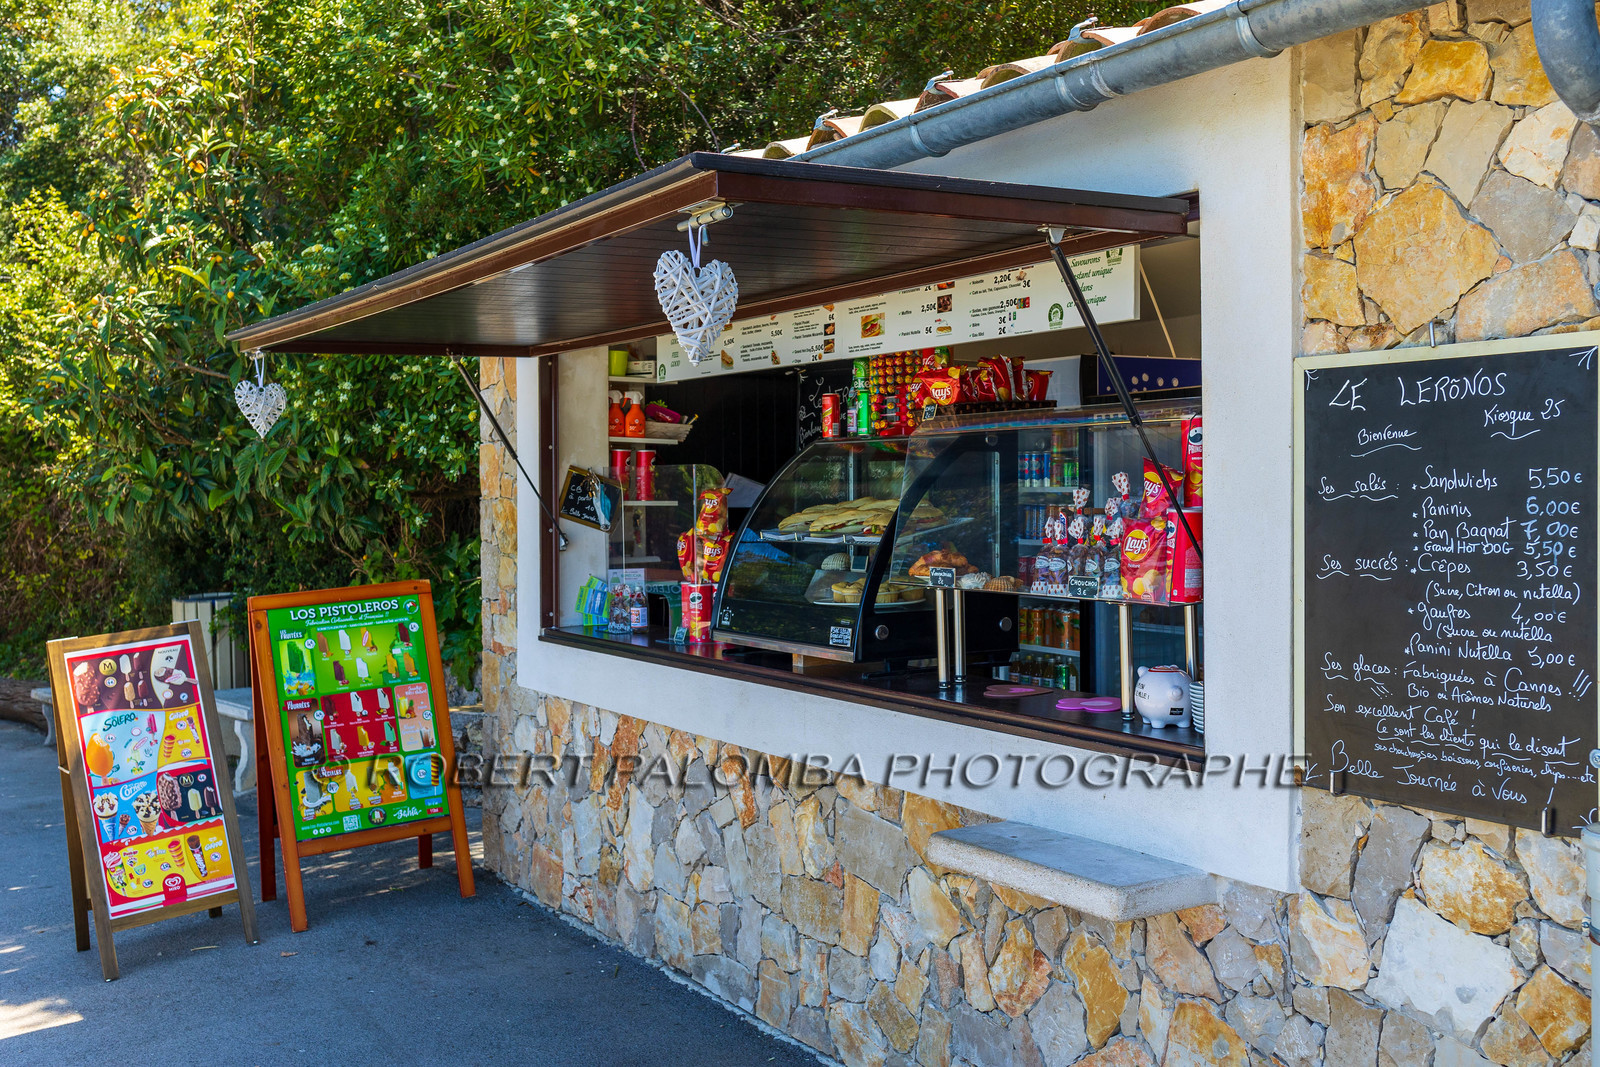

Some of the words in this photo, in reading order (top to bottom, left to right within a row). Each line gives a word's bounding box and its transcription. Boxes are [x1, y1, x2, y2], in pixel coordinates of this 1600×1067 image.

[1071, 256, 1101, 267] Savourons
[994, 274, 1011, 284] 2,20€
[1092, 267, 1113, 278] unique
[1023, 280, 1030, 288] 3€
[921, 303, 936, 312] 2,50€
[1000, 298, 1017, 308] 2,50€
[999, 316, 1006, 324] 3€
[925, 326, 932, 334] 5€
[998, 327, 1006, 335] 2€
[724, 338, 735, 346] 5,50€
[811, 344, 823, 352] 5,50€
[932, 388, 951, 400] Lay's
[1329, 378, 1367, 411] LE
[1484, 404, 1534, 435] Kiosque
[1540, 399, 1565, 418] 25
[1357, 424, 1417, 446] Bienvenue
[1318, 477, 1335, 495] Ses
[1420, 465, 1498, 493] Sandwichs
[1144, 481, 1160, 497] ay's
[1526, 496, 1580, 516] 6,00€
[1424, 520, 1448, 545] Pan
[1456, 517, 1517, 545] Bagnat
[704, 546, 721, 556] Lay's
[1126, 536, 1148, 555] Lay's
[1484, 542, 1514, 554] DOG
[1320, 554, 1342, 571] Ses
[1418, 553, 1471, 582] Crêpes
[1466, 583, 1501, 598] Citron
[1504, 588, 1518, 597] ou
[290, 608, 316, 621] LOS
[318, 599, 399, 617] PISTOLEROS
[1482, 628, 1498, 637] ou
[1409, 633, 1451, 655] Panini
[1458, 640, 1512, 661] Nutella
[1320, 652, 1342, 671] Ses
[1403, 660, 1475, 692] Fabriquées
[1484, 672, 1496, 687] à
[1504, 667, 1562, 696] Cannes
[1408, 683, 1430, 698] Bio
[1451, 688, 1494, 706] Arômes
[1497, 691, 1552, 713] Naturels
[103, 712, 136, 731] SOLERO
[1324, 694, 1346, 714] Son
[1355, 705, 1422, 723] excellent
[1424, 706, 1459, 735] Café
[1376, 718, 1388, 734] Ce
[1394, 723, 1416, 737] sont
[1420, 724, 1434, 739] les
[1480, 737, 1500, 759] qui
[1509, 733, 1522, 751] le
[1526, 736, 1580, 757] disent
[1329, 740, 1384, 778] Belle
[1393, 764, 1457, 791] Journée
[1472, 779, 1486, 797] à
[1492, 778, 1527, 804] Vous
